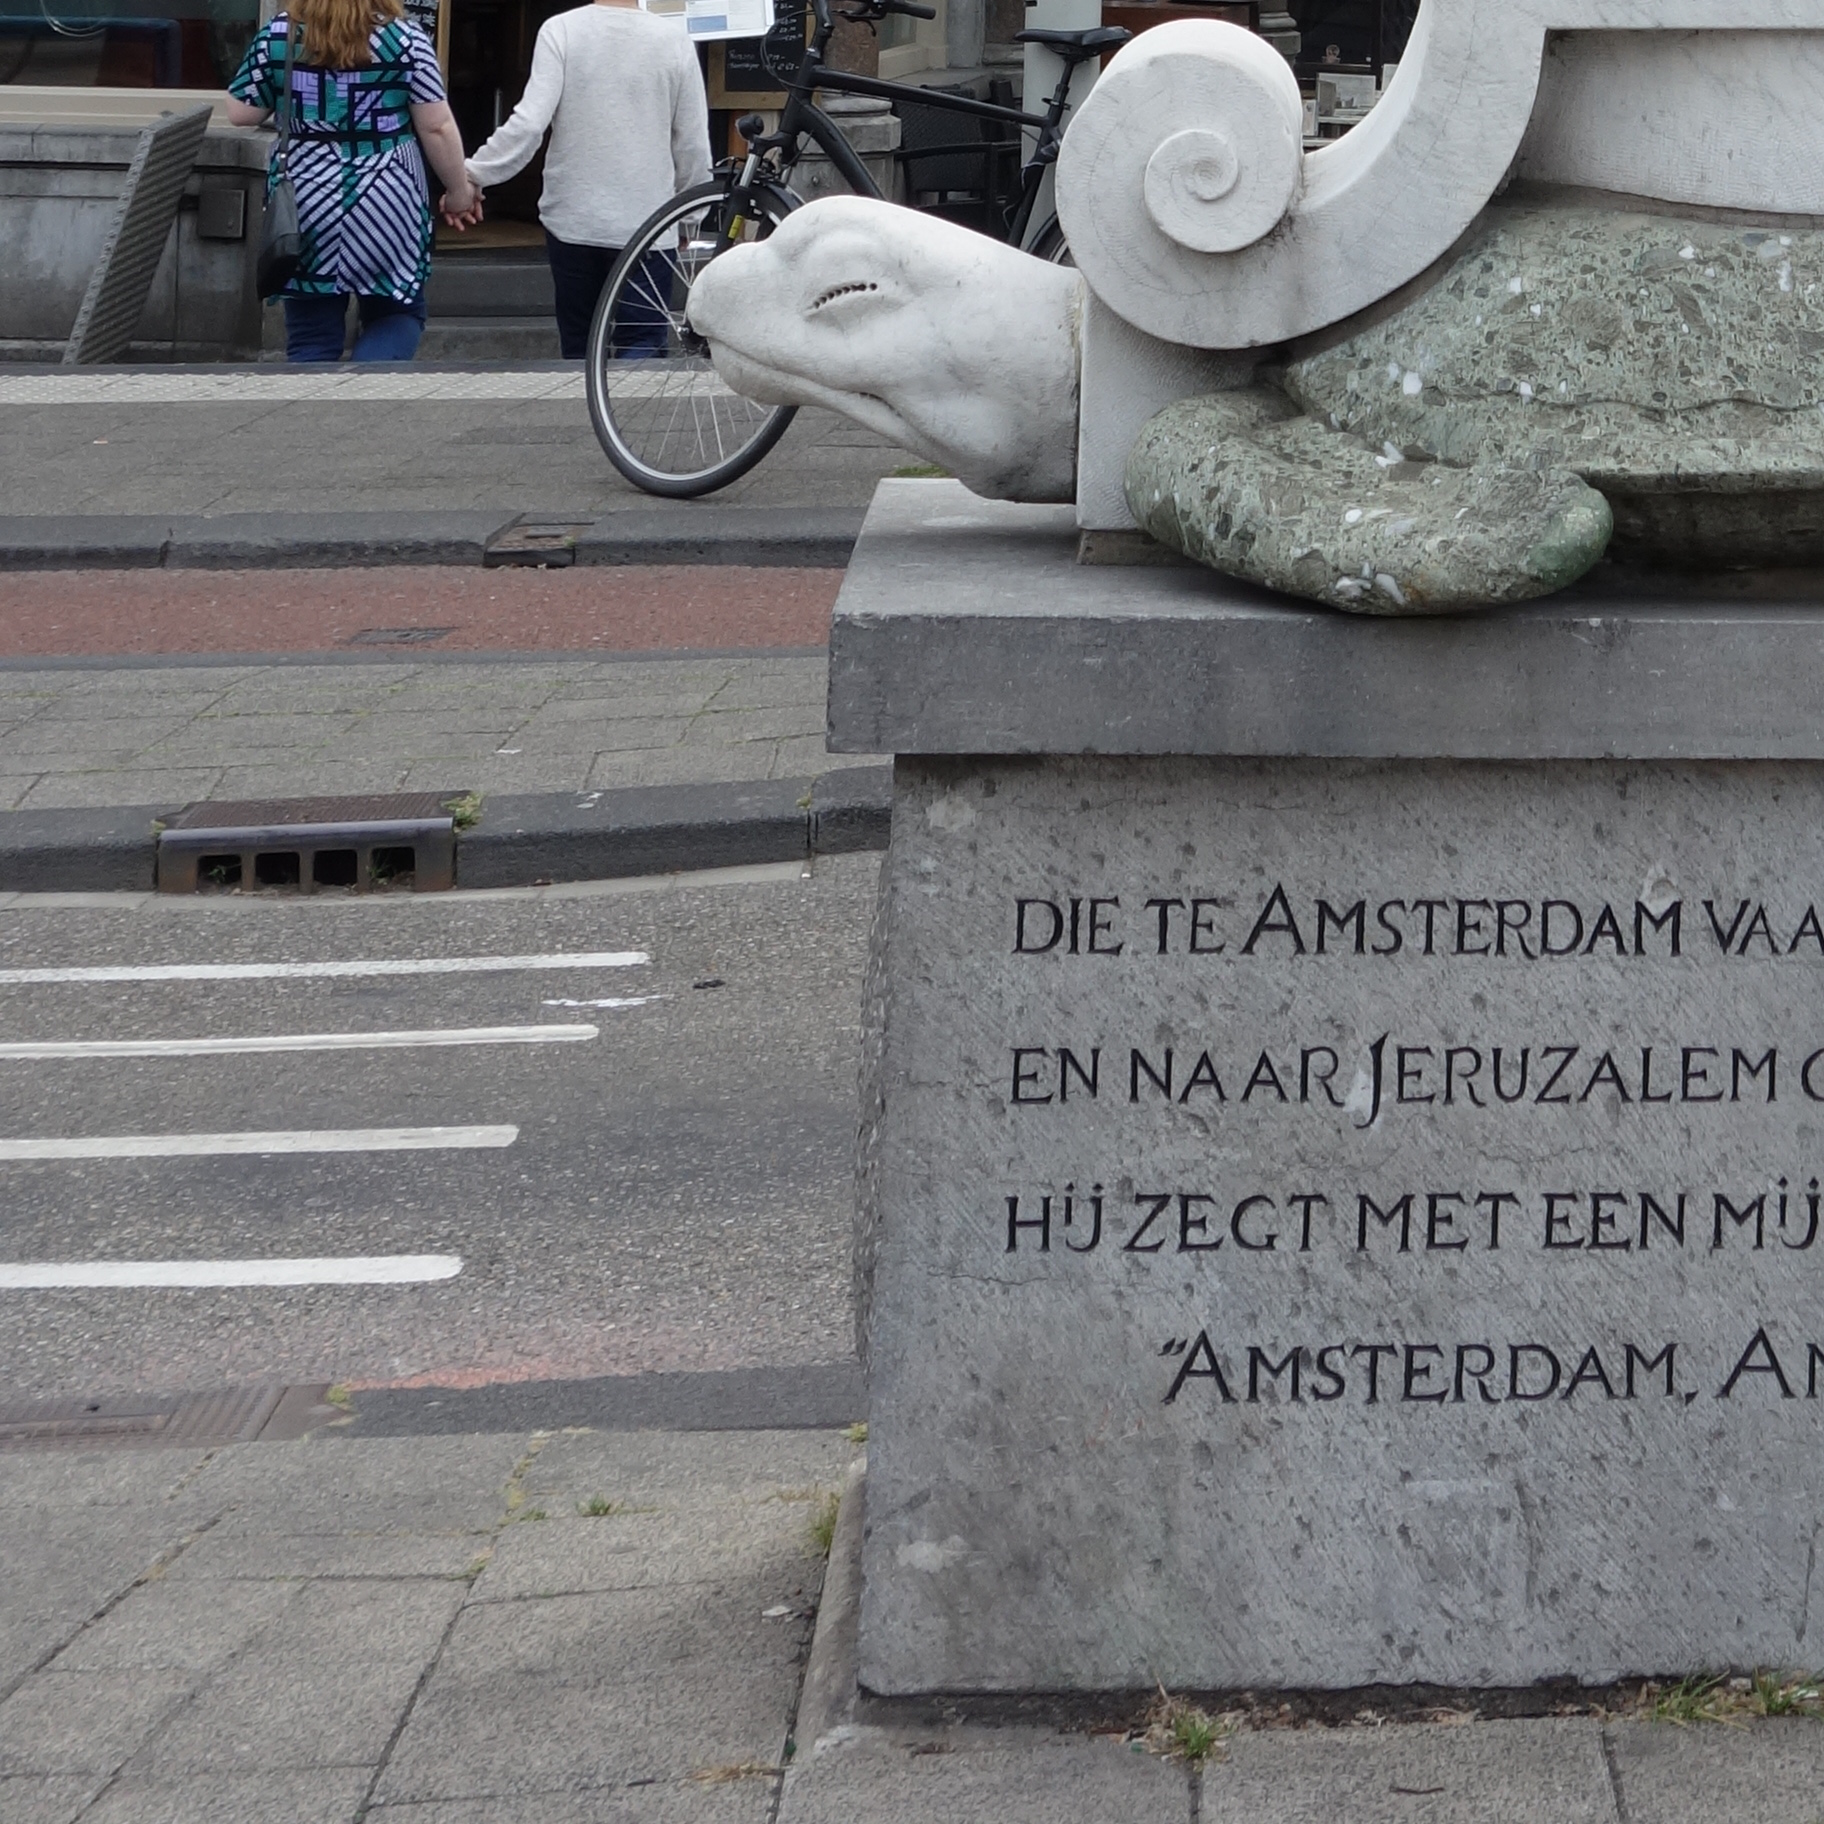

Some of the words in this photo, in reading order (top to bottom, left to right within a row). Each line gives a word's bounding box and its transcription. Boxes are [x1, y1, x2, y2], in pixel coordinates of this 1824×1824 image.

[1011, 897, 1124, 956] DIE
[1145, 897, 1226, 955] TE
[1243, 883, 1684, 960] AMSTERDAM
[1009, 1046, 1099, 1105] EN
[1128, 1045, 1345, 1109] NAAR
[1354, 1030, 1778, 1130] JERUZALEM
[1123, 1193, 1329, 1253] ZEGT
[1355, 1193, 1521, 1253] MET
[1540, 1192, 1687, 1253] EEN
